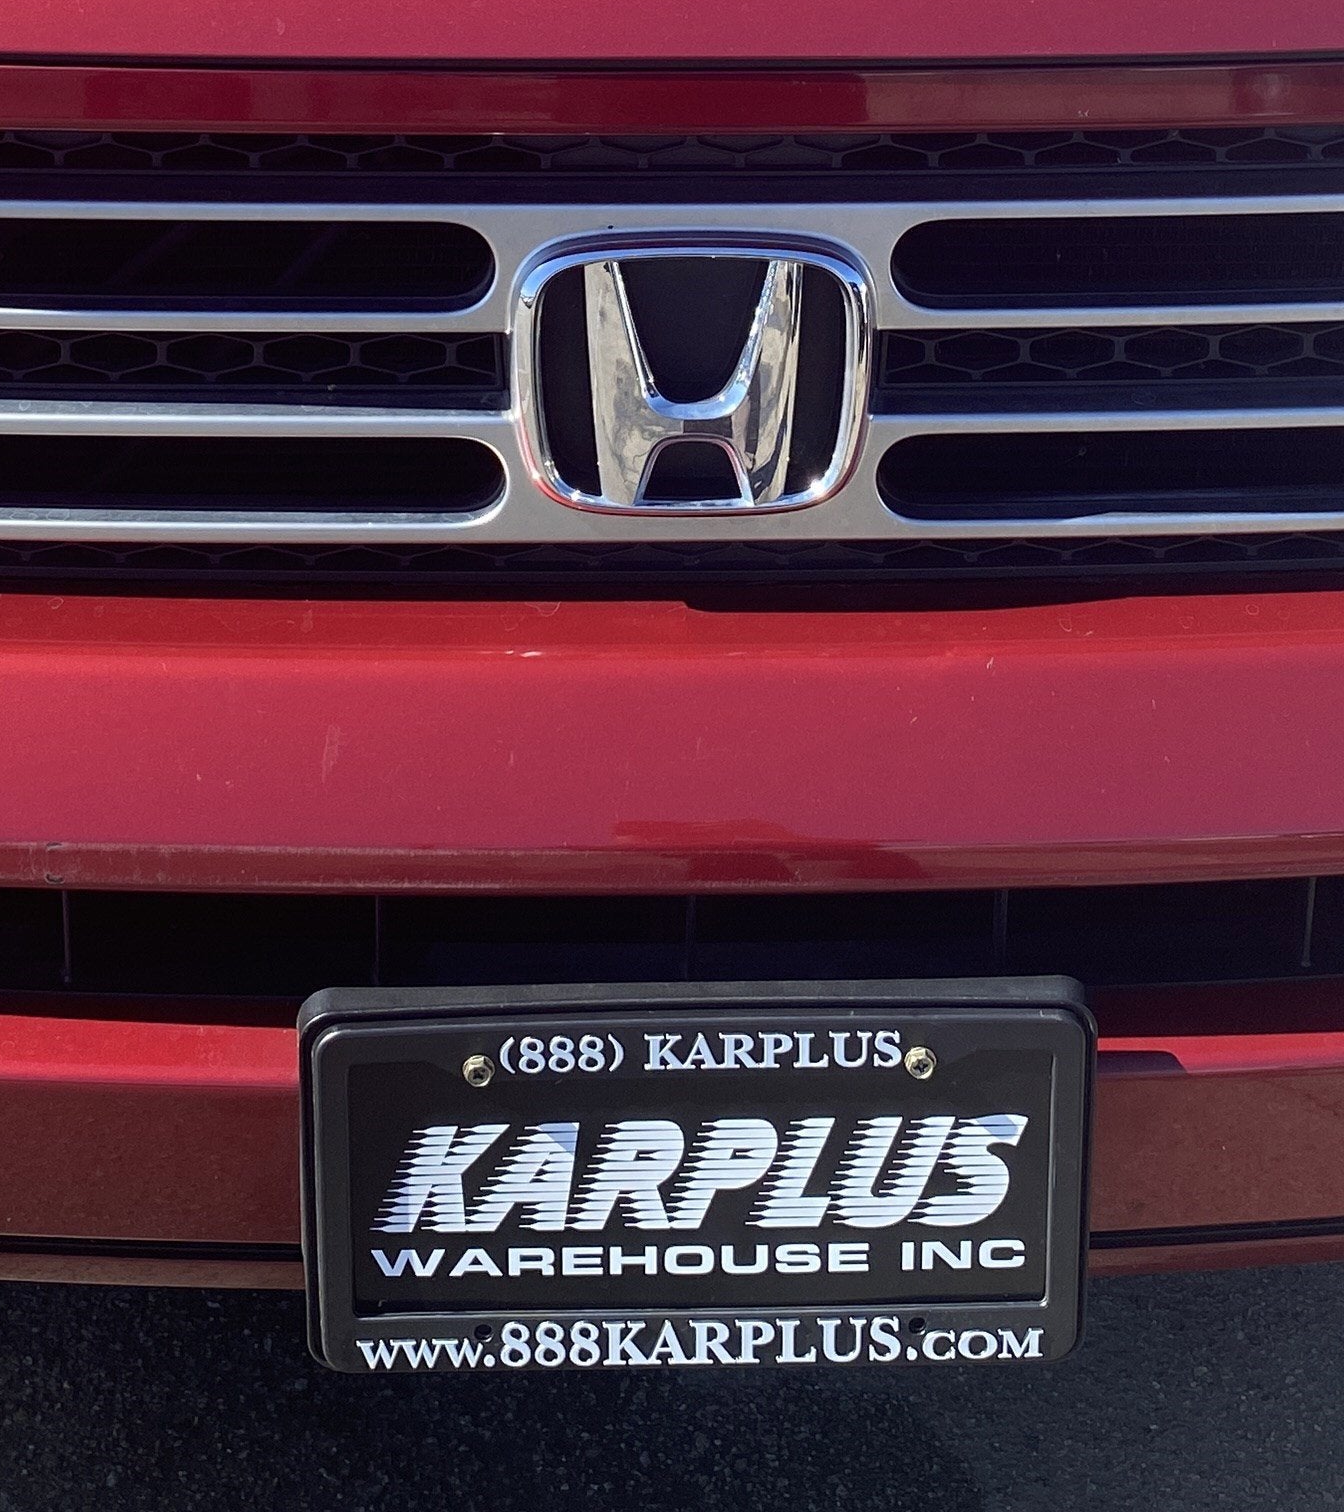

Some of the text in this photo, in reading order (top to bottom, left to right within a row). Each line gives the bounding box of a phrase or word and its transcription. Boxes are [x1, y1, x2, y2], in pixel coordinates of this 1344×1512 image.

[499, 1029, 903, 1074] (888) KARPLUS
[369, 1113, 1029, 1233] KARPLUS
[370, 1238, 1026, 1277] WAREHOUSE INC
